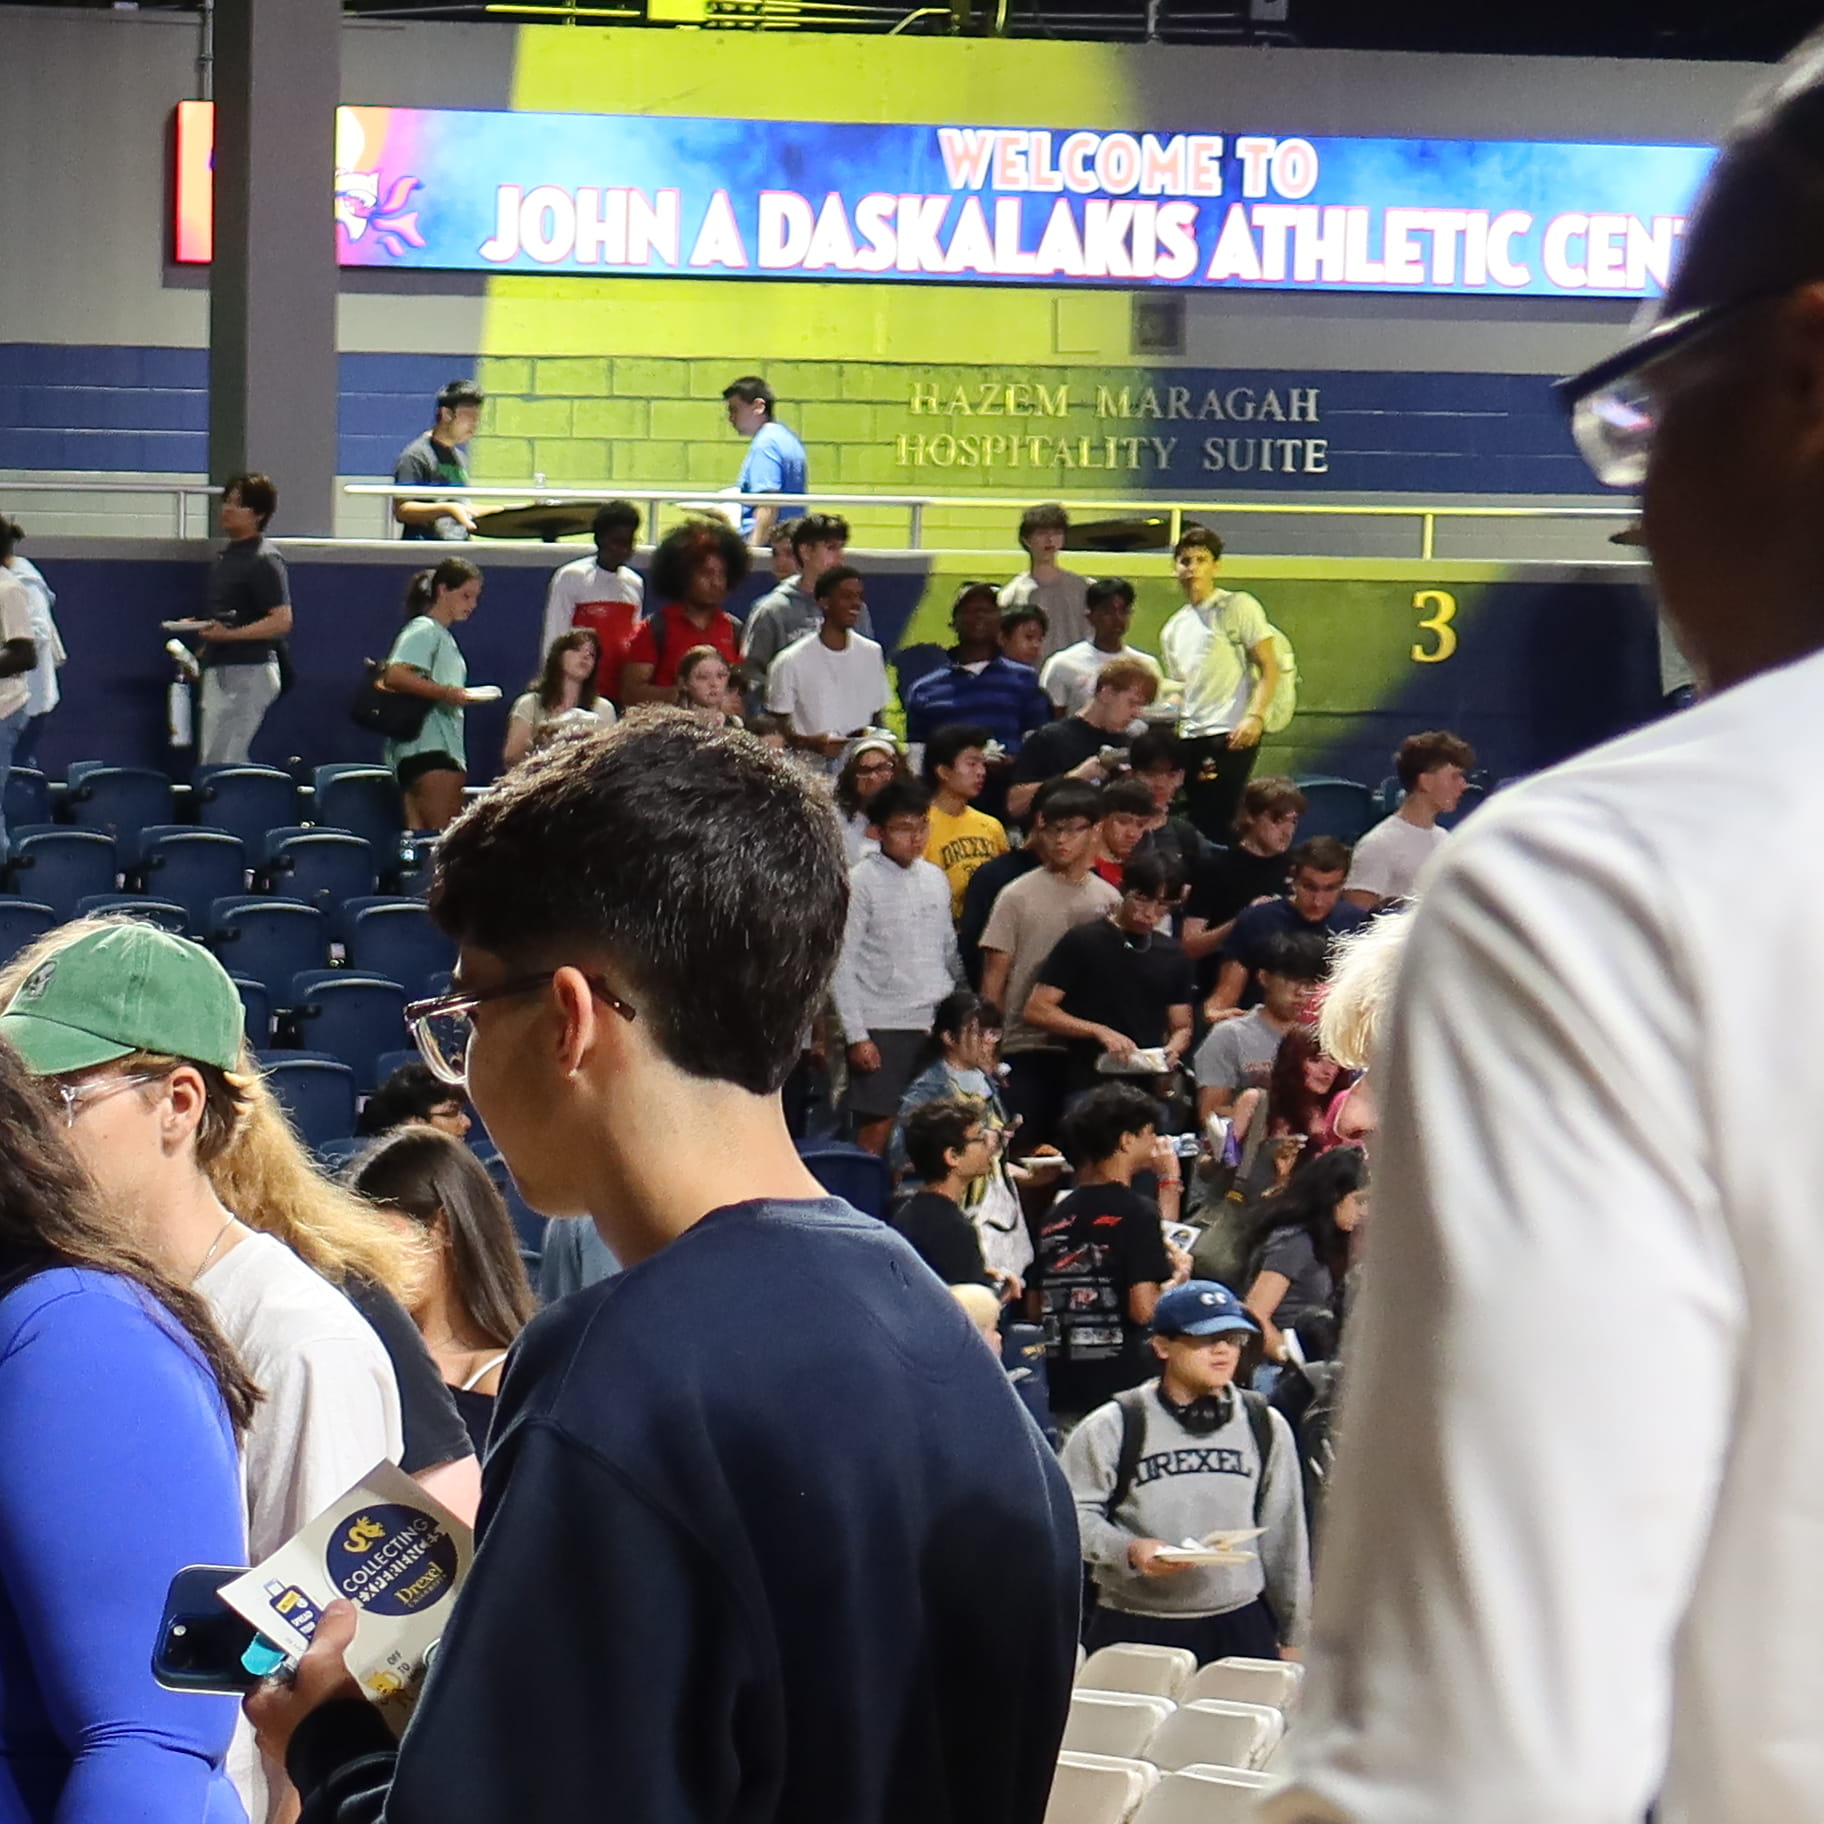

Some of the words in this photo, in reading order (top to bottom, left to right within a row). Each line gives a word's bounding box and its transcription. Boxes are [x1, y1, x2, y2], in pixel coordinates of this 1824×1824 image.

[938, 129, 1222, 198] WELCOME
[1237, 138, 1319, 198] TO
[478, 183, 682, 266] JOHN
[689, 190, 748, 267] A
[758, 190, 1199, 281] DASKALAKIS
[1207, 203, 1532, 289] ATHLETIC
[910, 382, 1071, 419] HAZEM
[1096, 384, 1321, 422] MARAGAH
[895, 432, 1178, 470] HOSPITALITY
[1203, 437, 1328, 473] SUITE
[1411, 590, 1456, 662] 3
[343, 1518, 428, 1592] COLLECTING
[394, 1562, 444, 1603] Drexel
